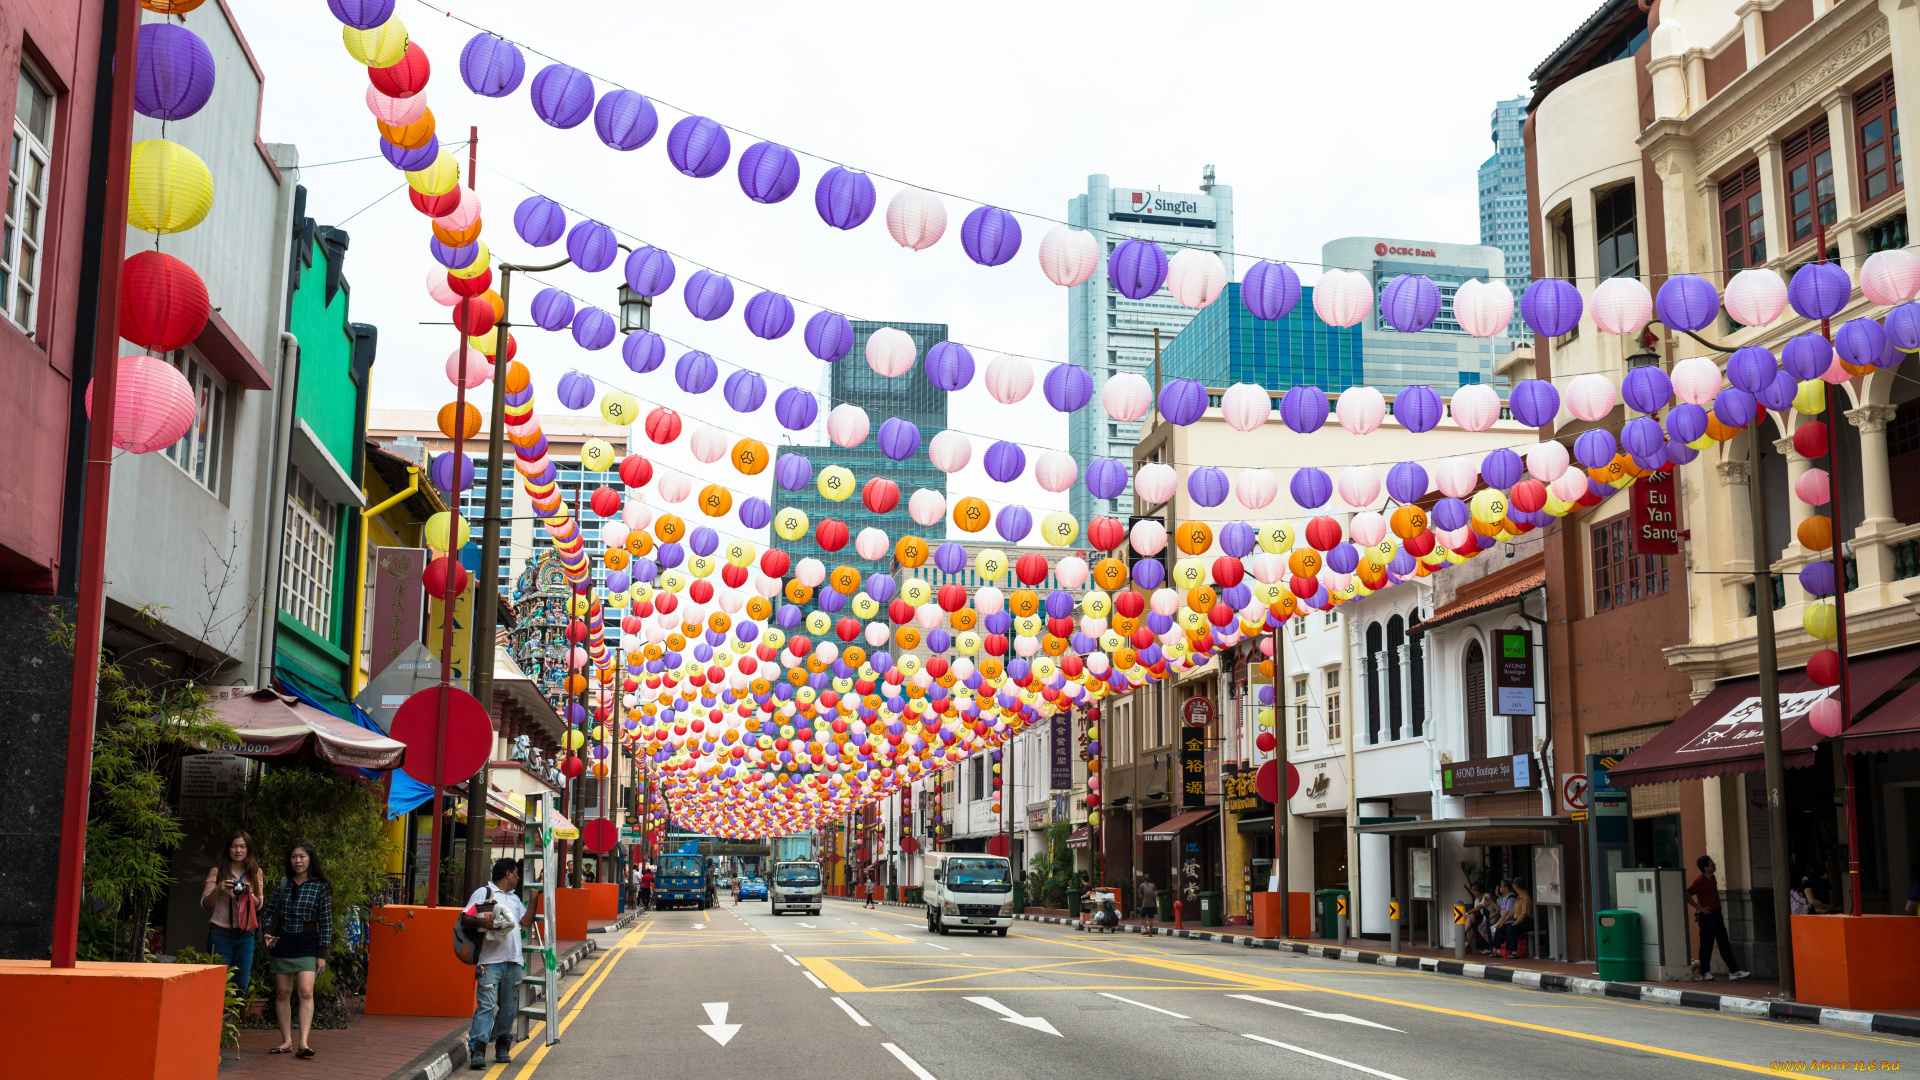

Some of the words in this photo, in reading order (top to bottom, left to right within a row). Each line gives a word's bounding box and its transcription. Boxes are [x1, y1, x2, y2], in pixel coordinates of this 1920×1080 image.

[1155, 198, 1197, 214] SingTel
[1389, 246, 1413, 255] OCBC
[1416, 248, 1436, 257] Bank
[1649, 490, 1667, 504] Eu
[1647, 507, 1672, 521] Yan
[1643, 525, 1678, 542] Sang
[1456, 767, 1475, 778] AFOND
[1477, 765, 1498, 778] Boutique
[1500, 763, 1510, 776] Spa
